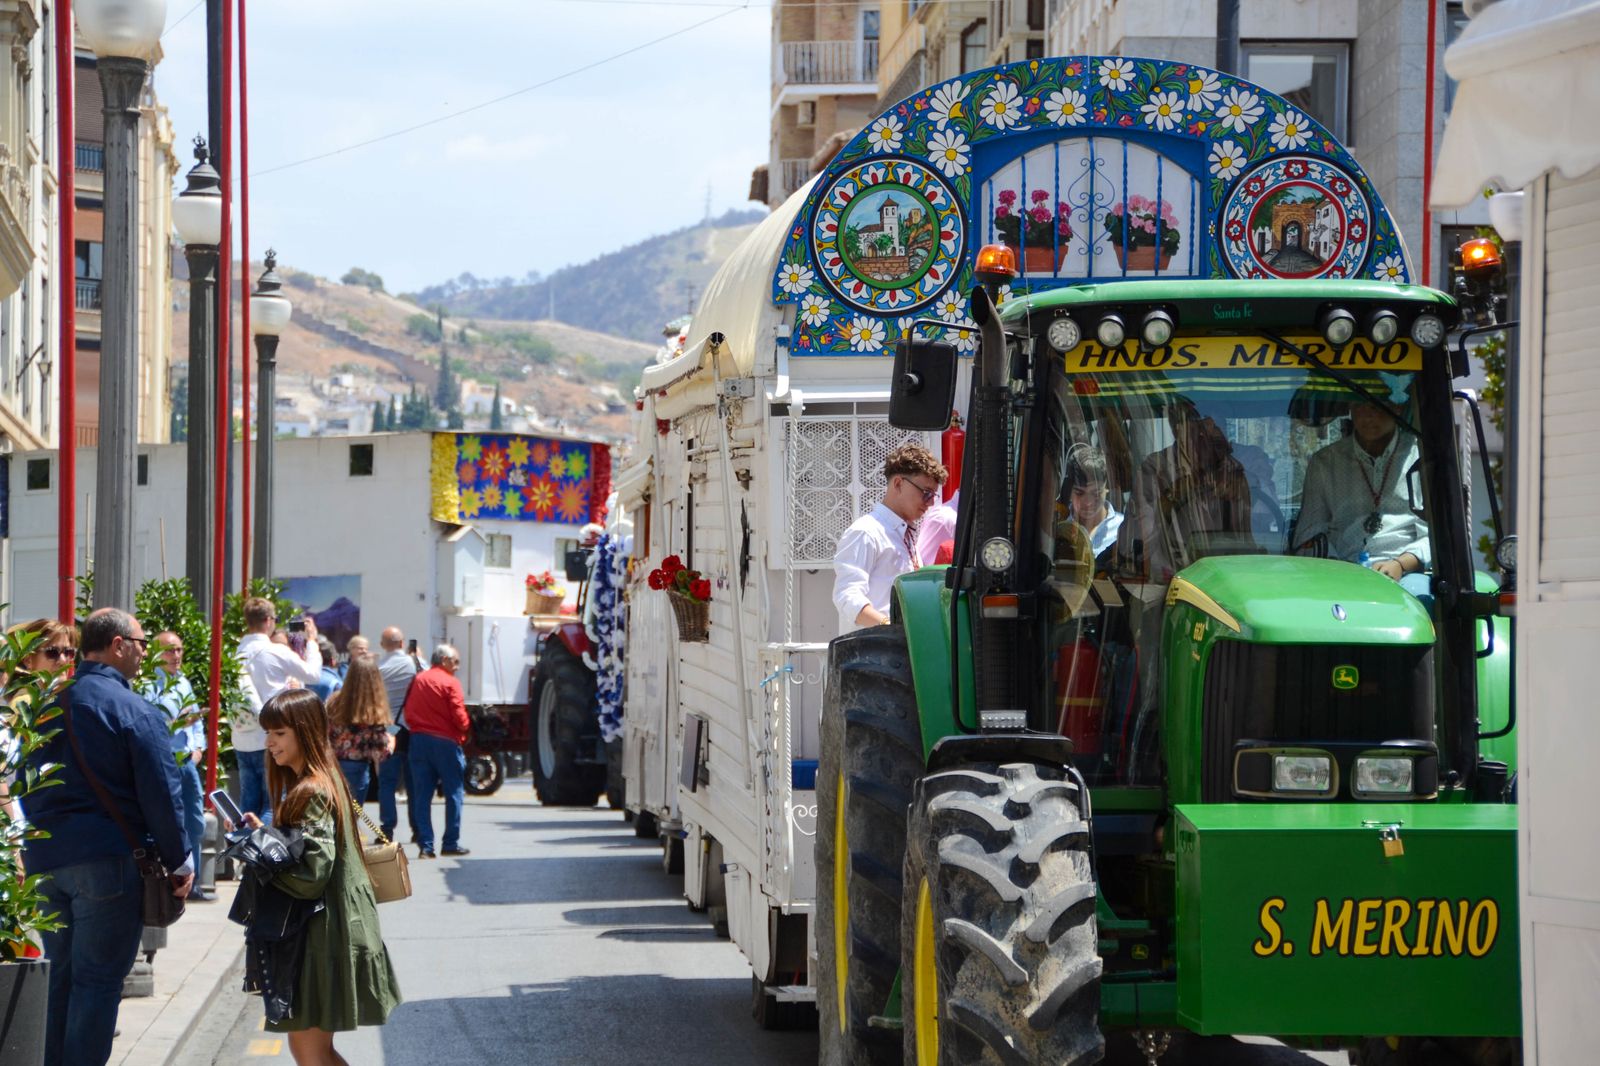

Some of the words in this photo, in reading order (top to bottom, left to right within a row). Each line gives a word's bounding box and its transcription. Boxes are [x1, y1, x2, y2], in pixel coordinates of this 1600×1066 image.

[1213, 303, 1241, 319] Santa
[1079, 344, 1208, 367] HNOS.
[1229, 342, 1409, 367] MERINO
[1252, 897, 1294, 957] S.
[1309, 897, 1500, 957] MERINO
